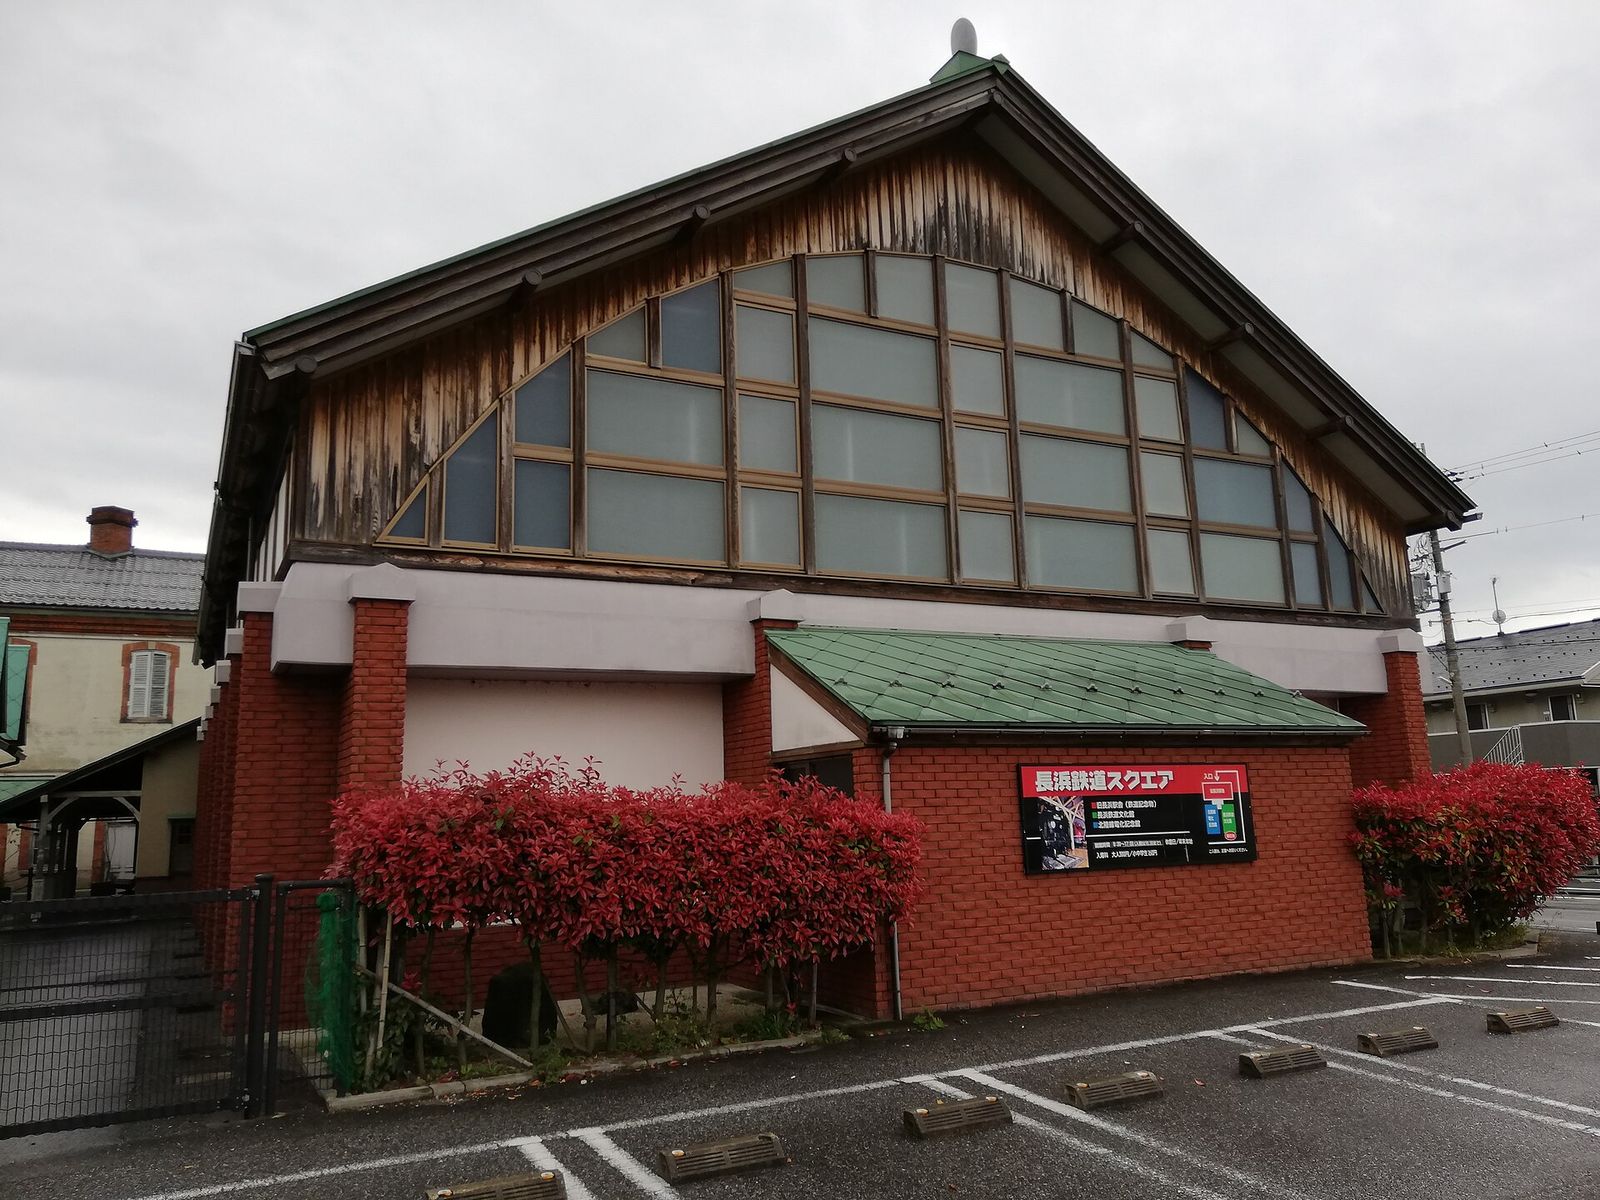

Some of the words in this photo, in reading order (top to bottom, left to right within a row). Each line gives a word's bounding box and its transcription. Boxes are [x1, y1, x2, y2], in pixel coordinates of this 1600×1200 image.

[1035, 770, 1174, 792] 長浜鉄道スクエア
